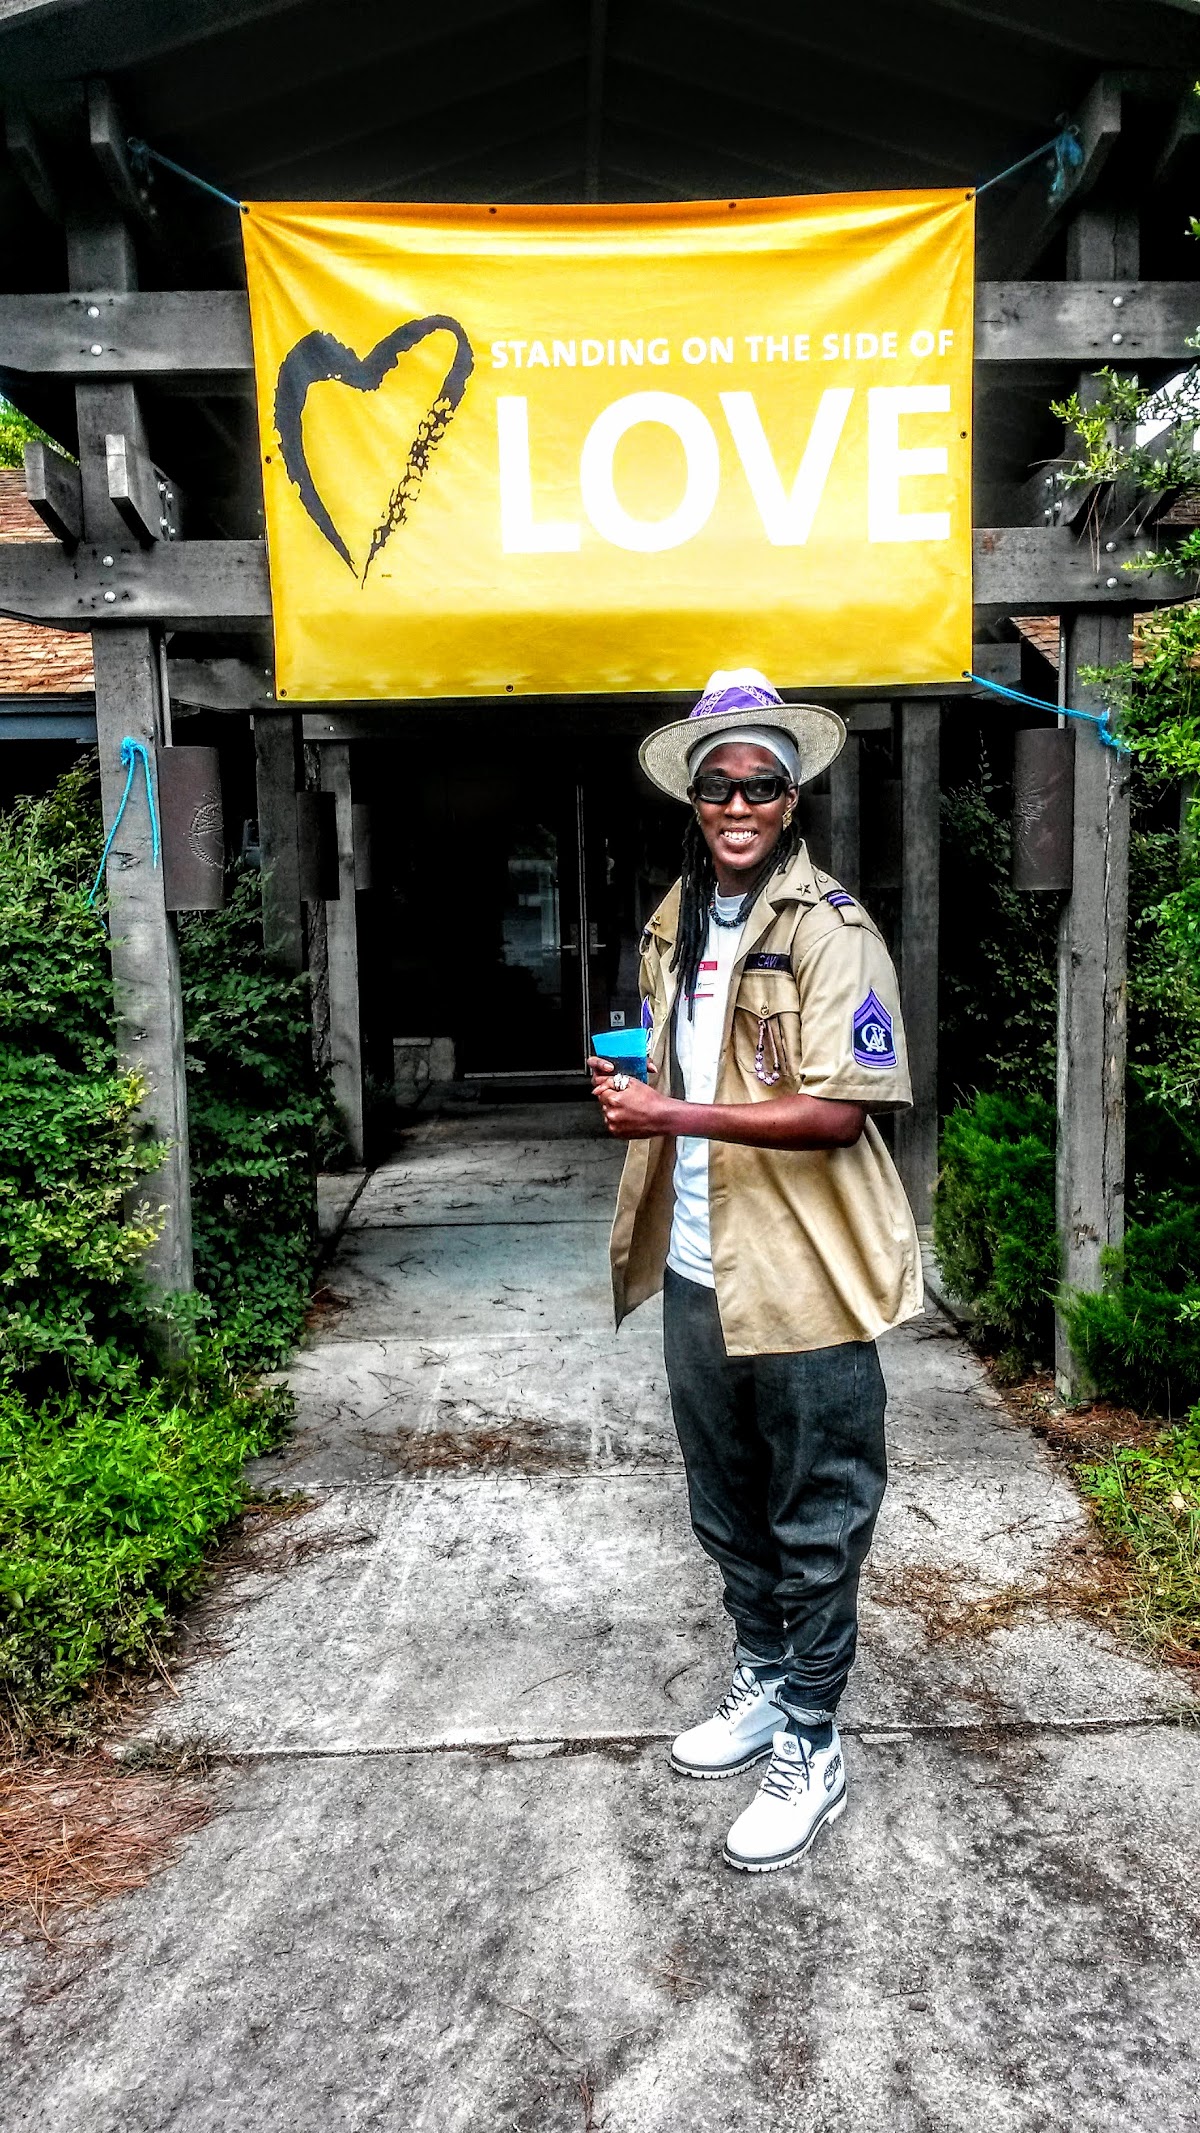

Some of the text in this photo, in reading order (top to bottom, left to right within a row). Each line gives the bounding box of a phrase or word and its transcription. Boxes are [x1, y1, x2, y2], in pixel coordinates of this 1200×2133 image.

[490, 328, 954, 369] STANDING ON THE SIDE OF
[496, 386, 951, 554] LOVE
